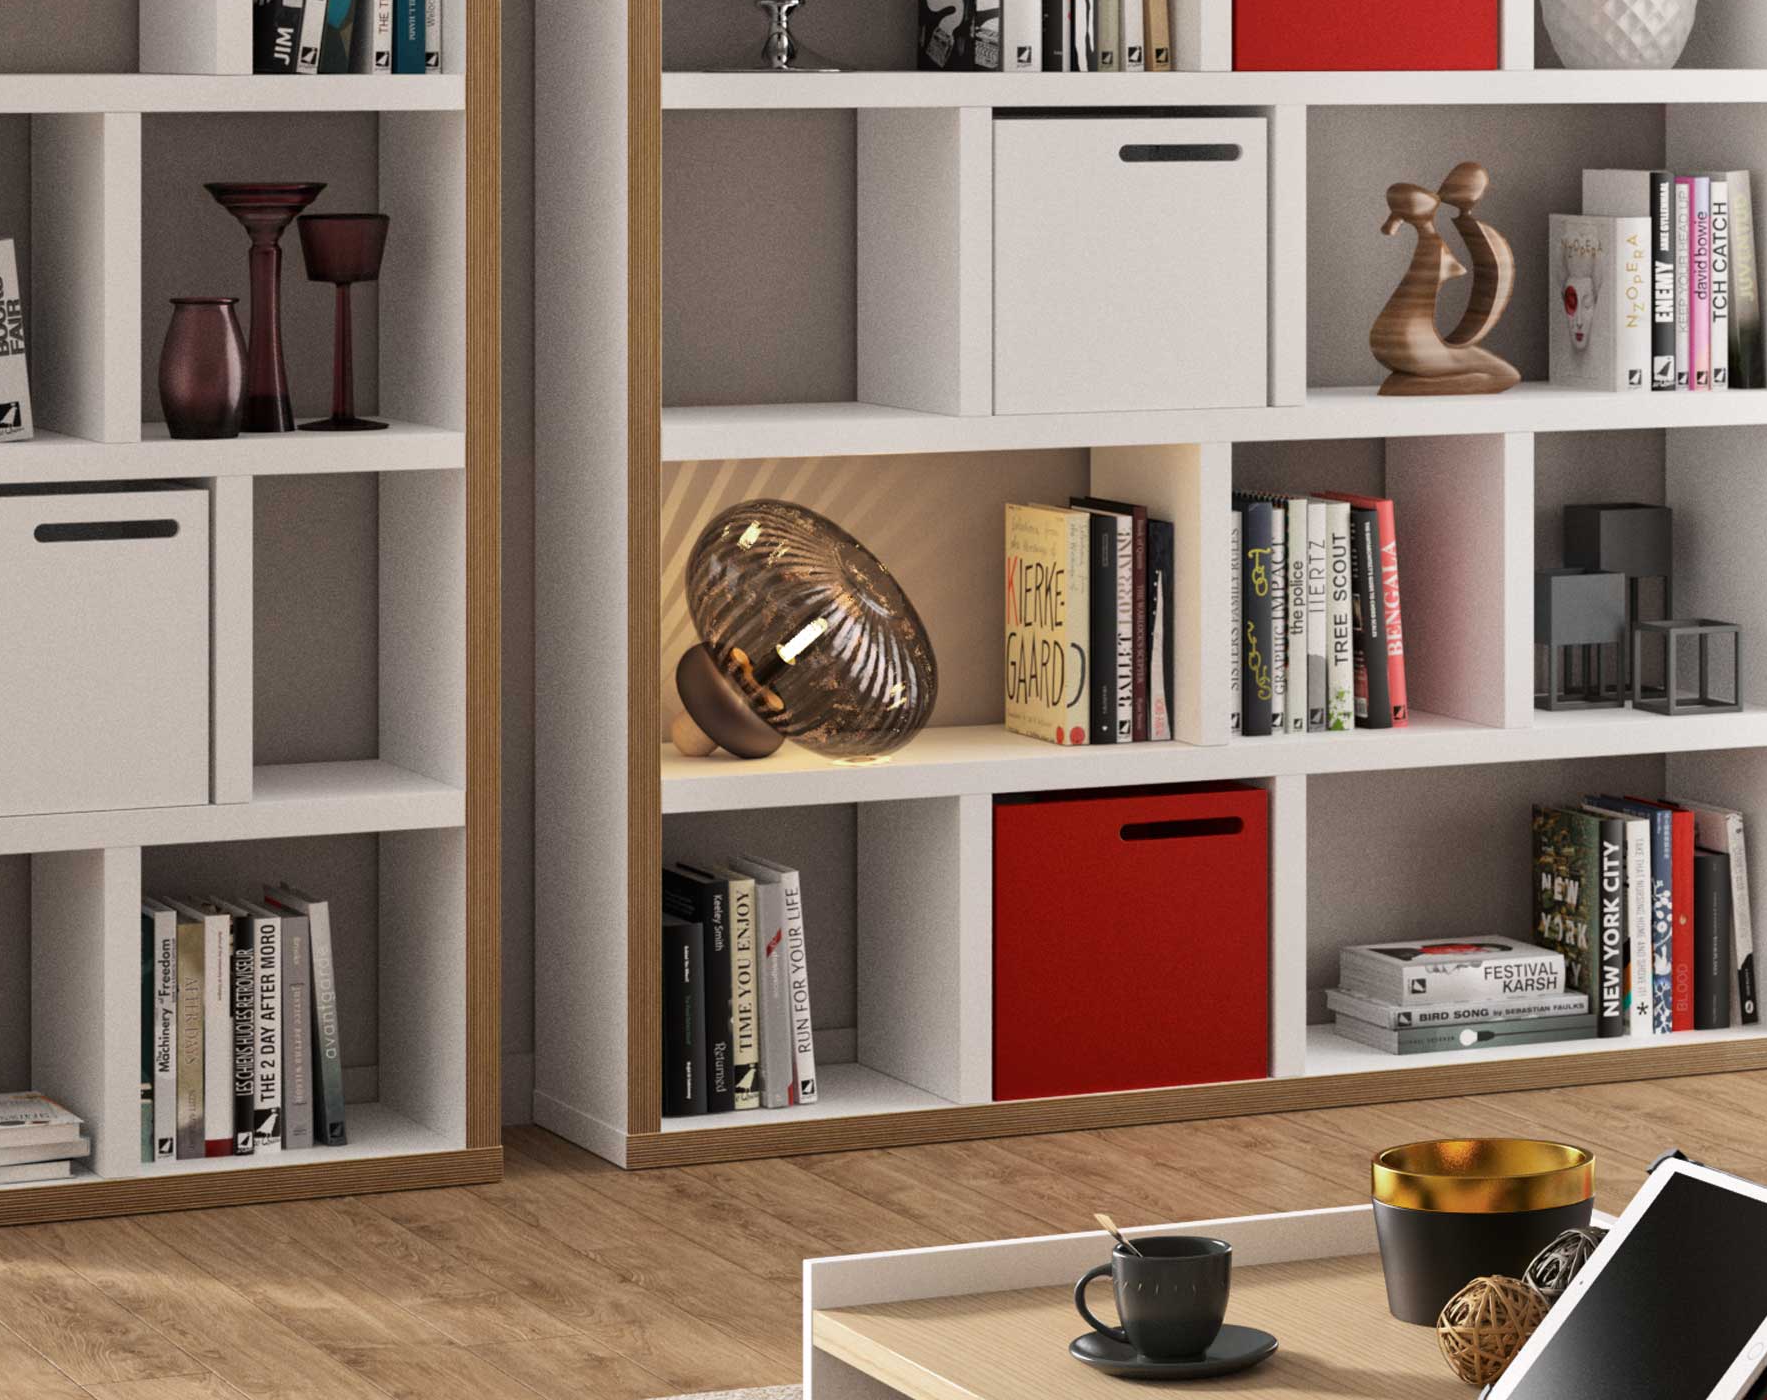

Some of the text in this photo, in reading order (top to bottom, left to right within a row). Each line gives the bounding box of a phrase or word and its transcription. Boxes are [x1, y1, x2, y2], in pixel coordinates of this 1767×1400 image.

[274, 27, 294, 66] JIM
[379, 16, 389, 34] THE
[1655, 261, 1674, 323] ENEMY
[1693, 211, 1708, 300] david bowie
[1713, 201, 1727, 322] TCH CATCH
[7, 298, 26, 355] FAIR
[1291, 560, 1304, 635] the police
[1332, 533, 1349, 666] TREE SCOUT
[1382, 541, 1403, 656] BENGALA
[1006, 631, 1065, 709] GAARD
[1603, 840, 1620, 1017] NEW YORK CITY
[736, 890, 752, 1053] TIME YOU ENJOY
[785, 888, 811, 1054] RUN FOR YOUR LIFE
[1483, 962, 1558, 980] FESTIVAL
[1502, 976, 1557, 993] KARSH
[260, 924, 275, 1102] THE 2 DAY AFTER MORO
